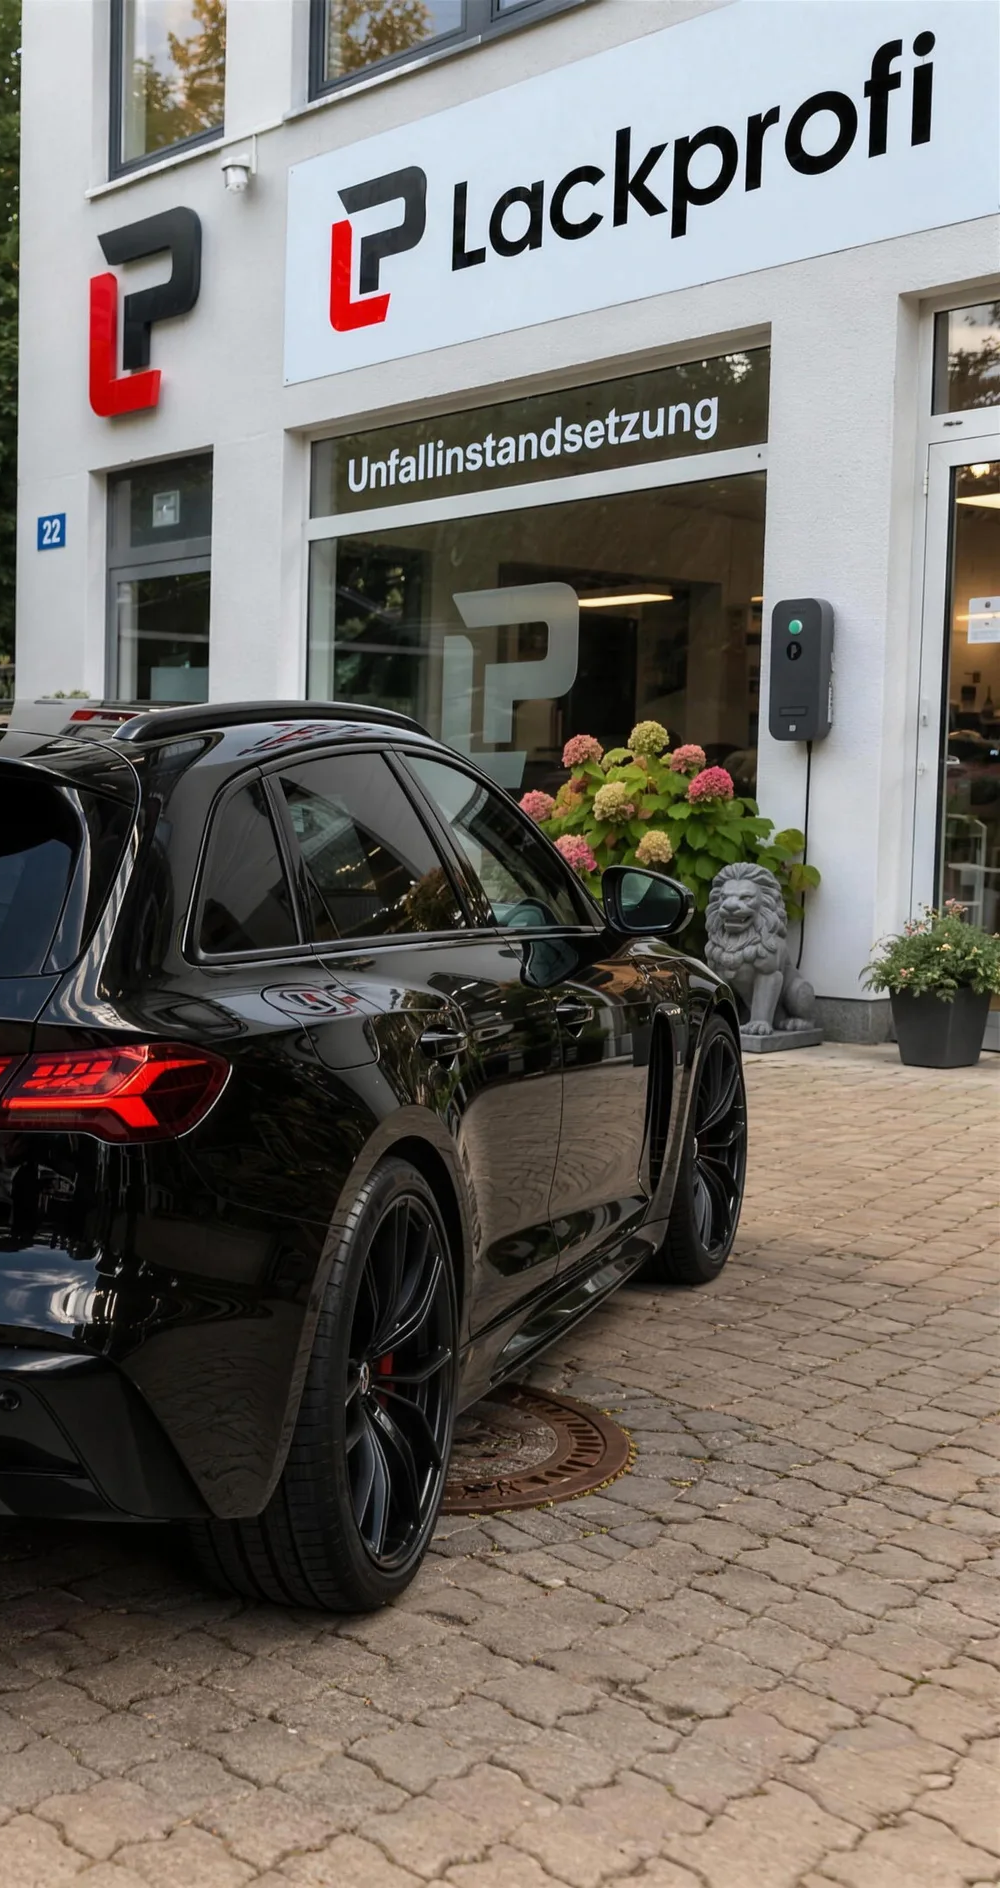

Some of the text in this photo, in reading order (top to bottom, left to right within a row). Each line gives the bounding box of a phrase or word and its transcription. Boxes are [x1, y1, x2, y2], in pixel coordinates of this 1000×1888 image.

[451, 30, 936, 272] Lackprofi
[347, 396, 719, 493] Unfallinstandsetzung
[42, 518, 61, 545] 22
